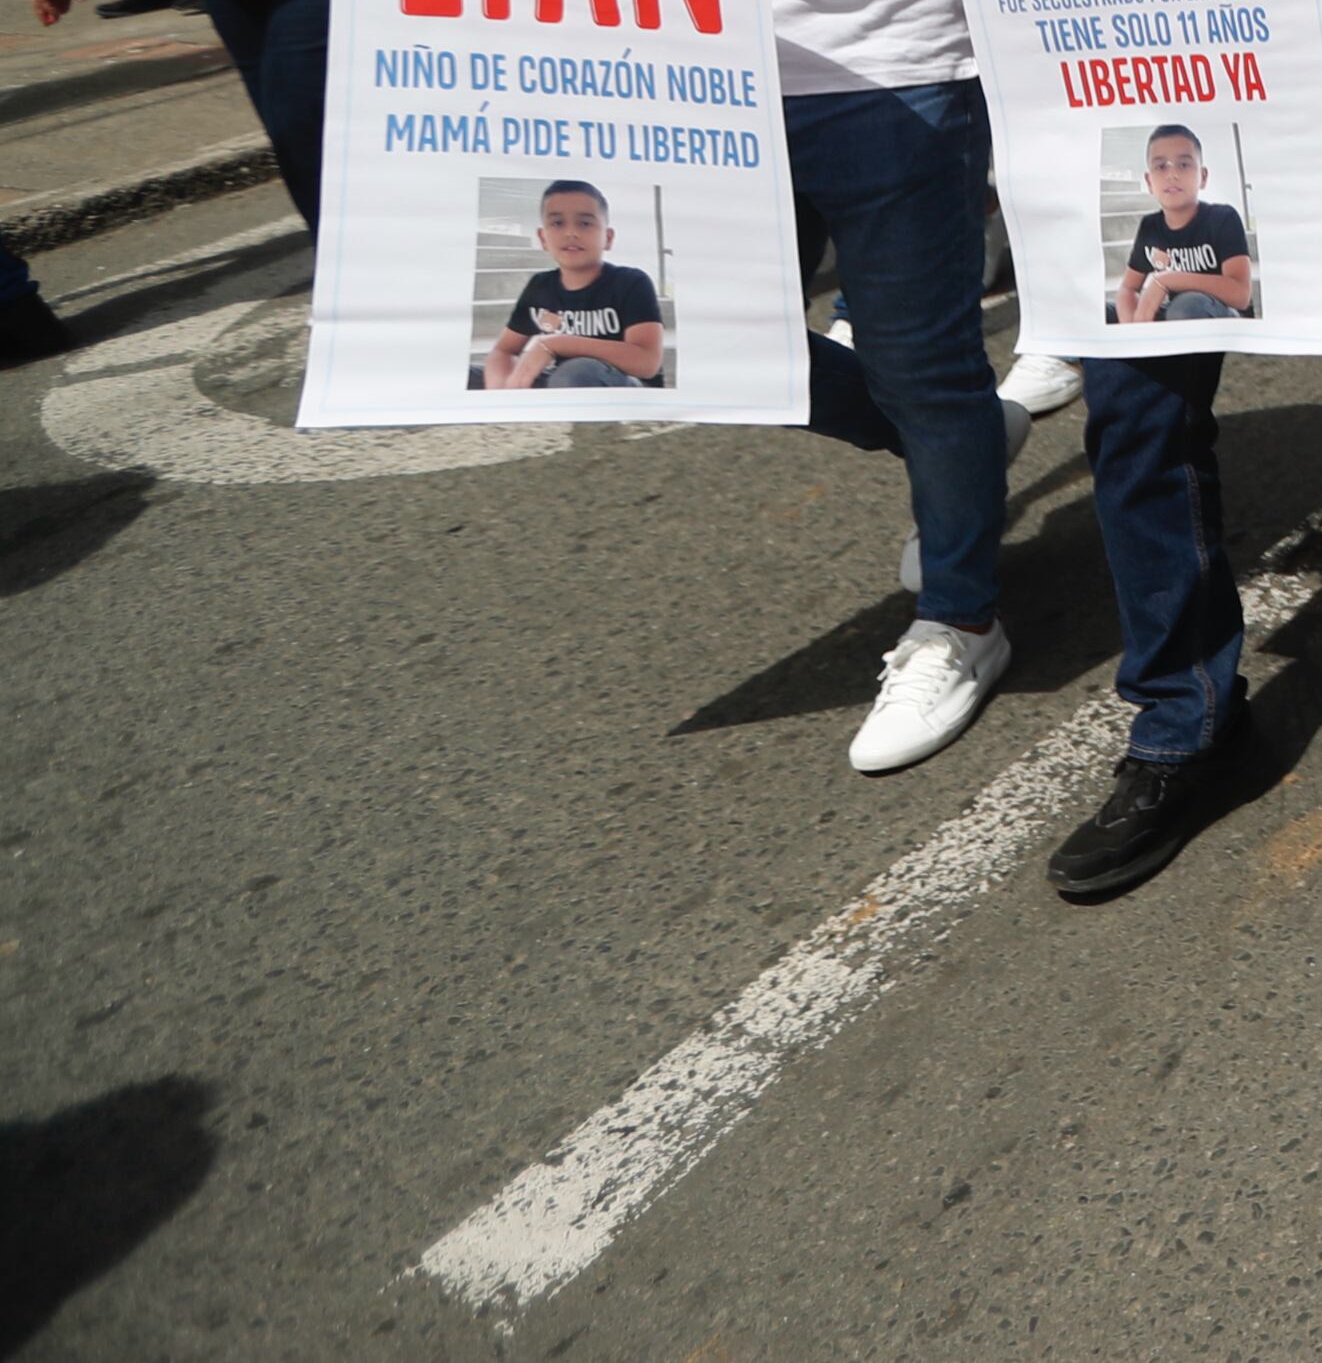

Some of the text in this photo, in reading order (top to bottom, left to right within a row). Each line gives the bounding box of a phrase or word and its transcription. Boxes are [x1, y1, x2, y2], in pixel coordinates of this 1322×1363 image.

[1035, 3, 1270, 54] TIENE SOLO 11 AÑOS
[374, 44, 758, 109] NIÑO DE CORAZÓN NOBLE
[1060, 52, 1268, 108] LIBERTAD YA
[385, 101, 761, 169] MAMÁ PIDE TU LIBERTAD
